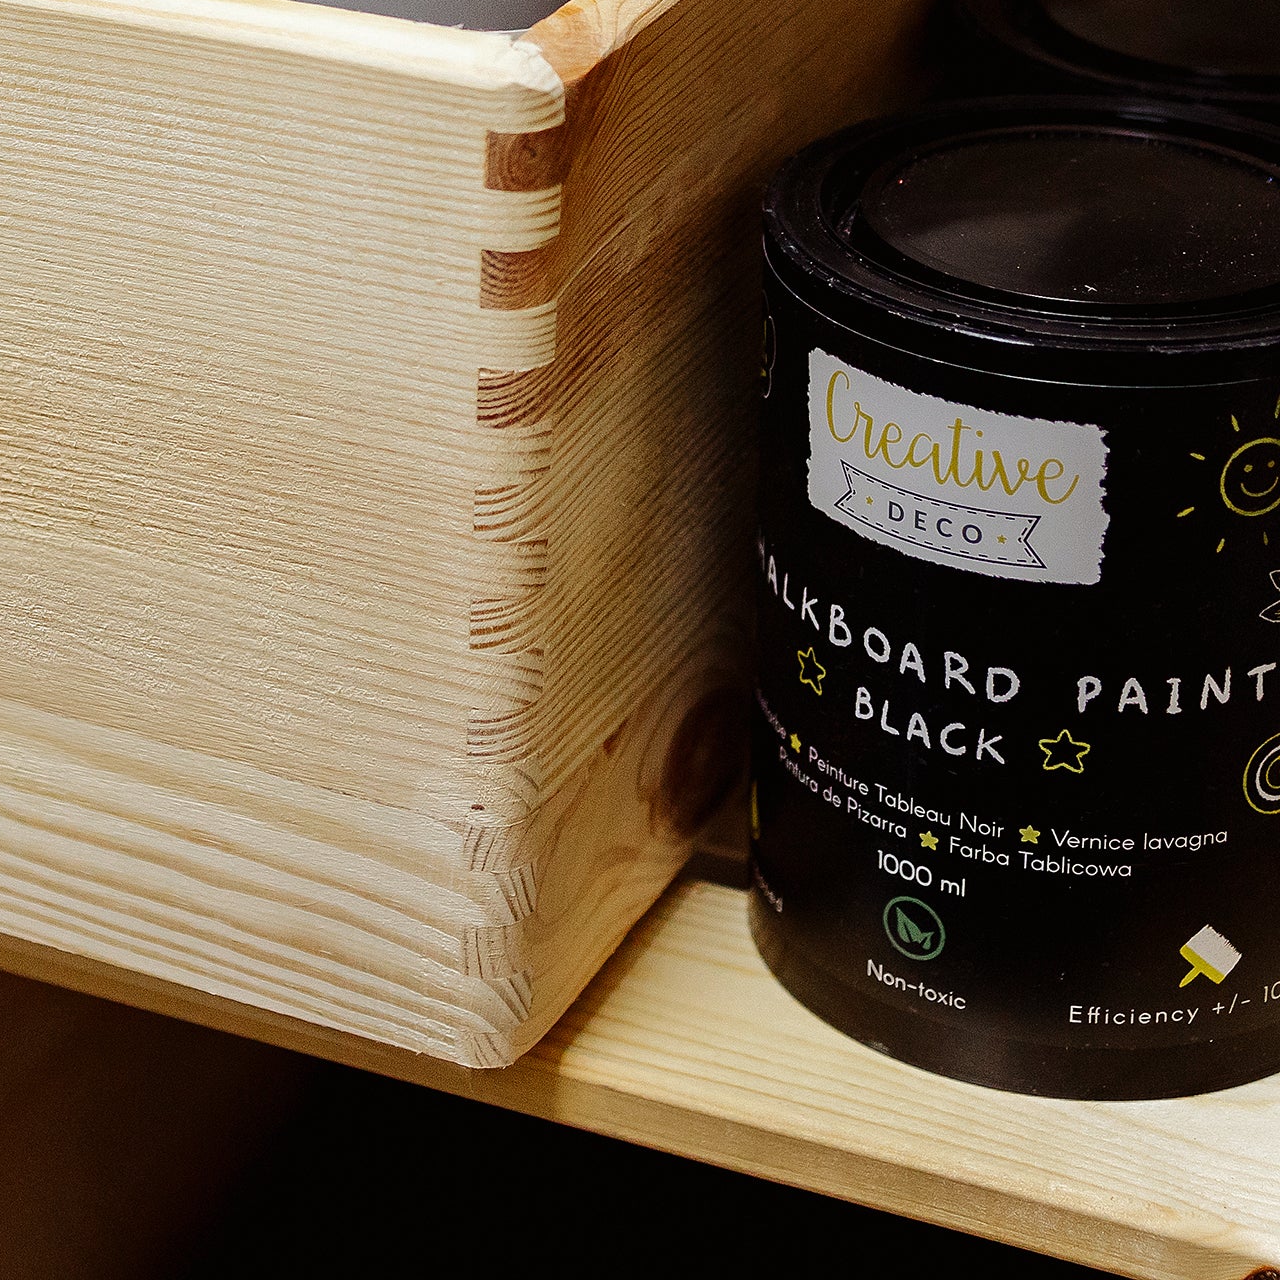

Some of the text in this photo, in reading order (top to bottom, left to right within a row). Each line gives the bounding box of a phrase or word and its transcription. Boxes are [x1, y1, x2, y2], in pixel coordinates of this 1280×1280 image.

[825, 369, 1080, 505] Creative
[887, 499, 983, 545] DECO
[1076, 661, 1277, 715] PAINT
[854, 686, 1006, 765] BLACK
[808, 745, 1228, 852] Peinture Tableau Noir Vernice lavagna
[822, 786, 842, 808] de
[846, 796, 908, 839] Pizarra
[949, 835, 1010, 867] Farba
[1017, 850, 1133, 877] Tablicowa
[877, 849, 967, 898] 1000 ml
[866, 958, 968, 1010] Non-toxic
[1069, 1004, 1200, 1025] Efficiency
[1211, 993, 1252, 1015] +/-
